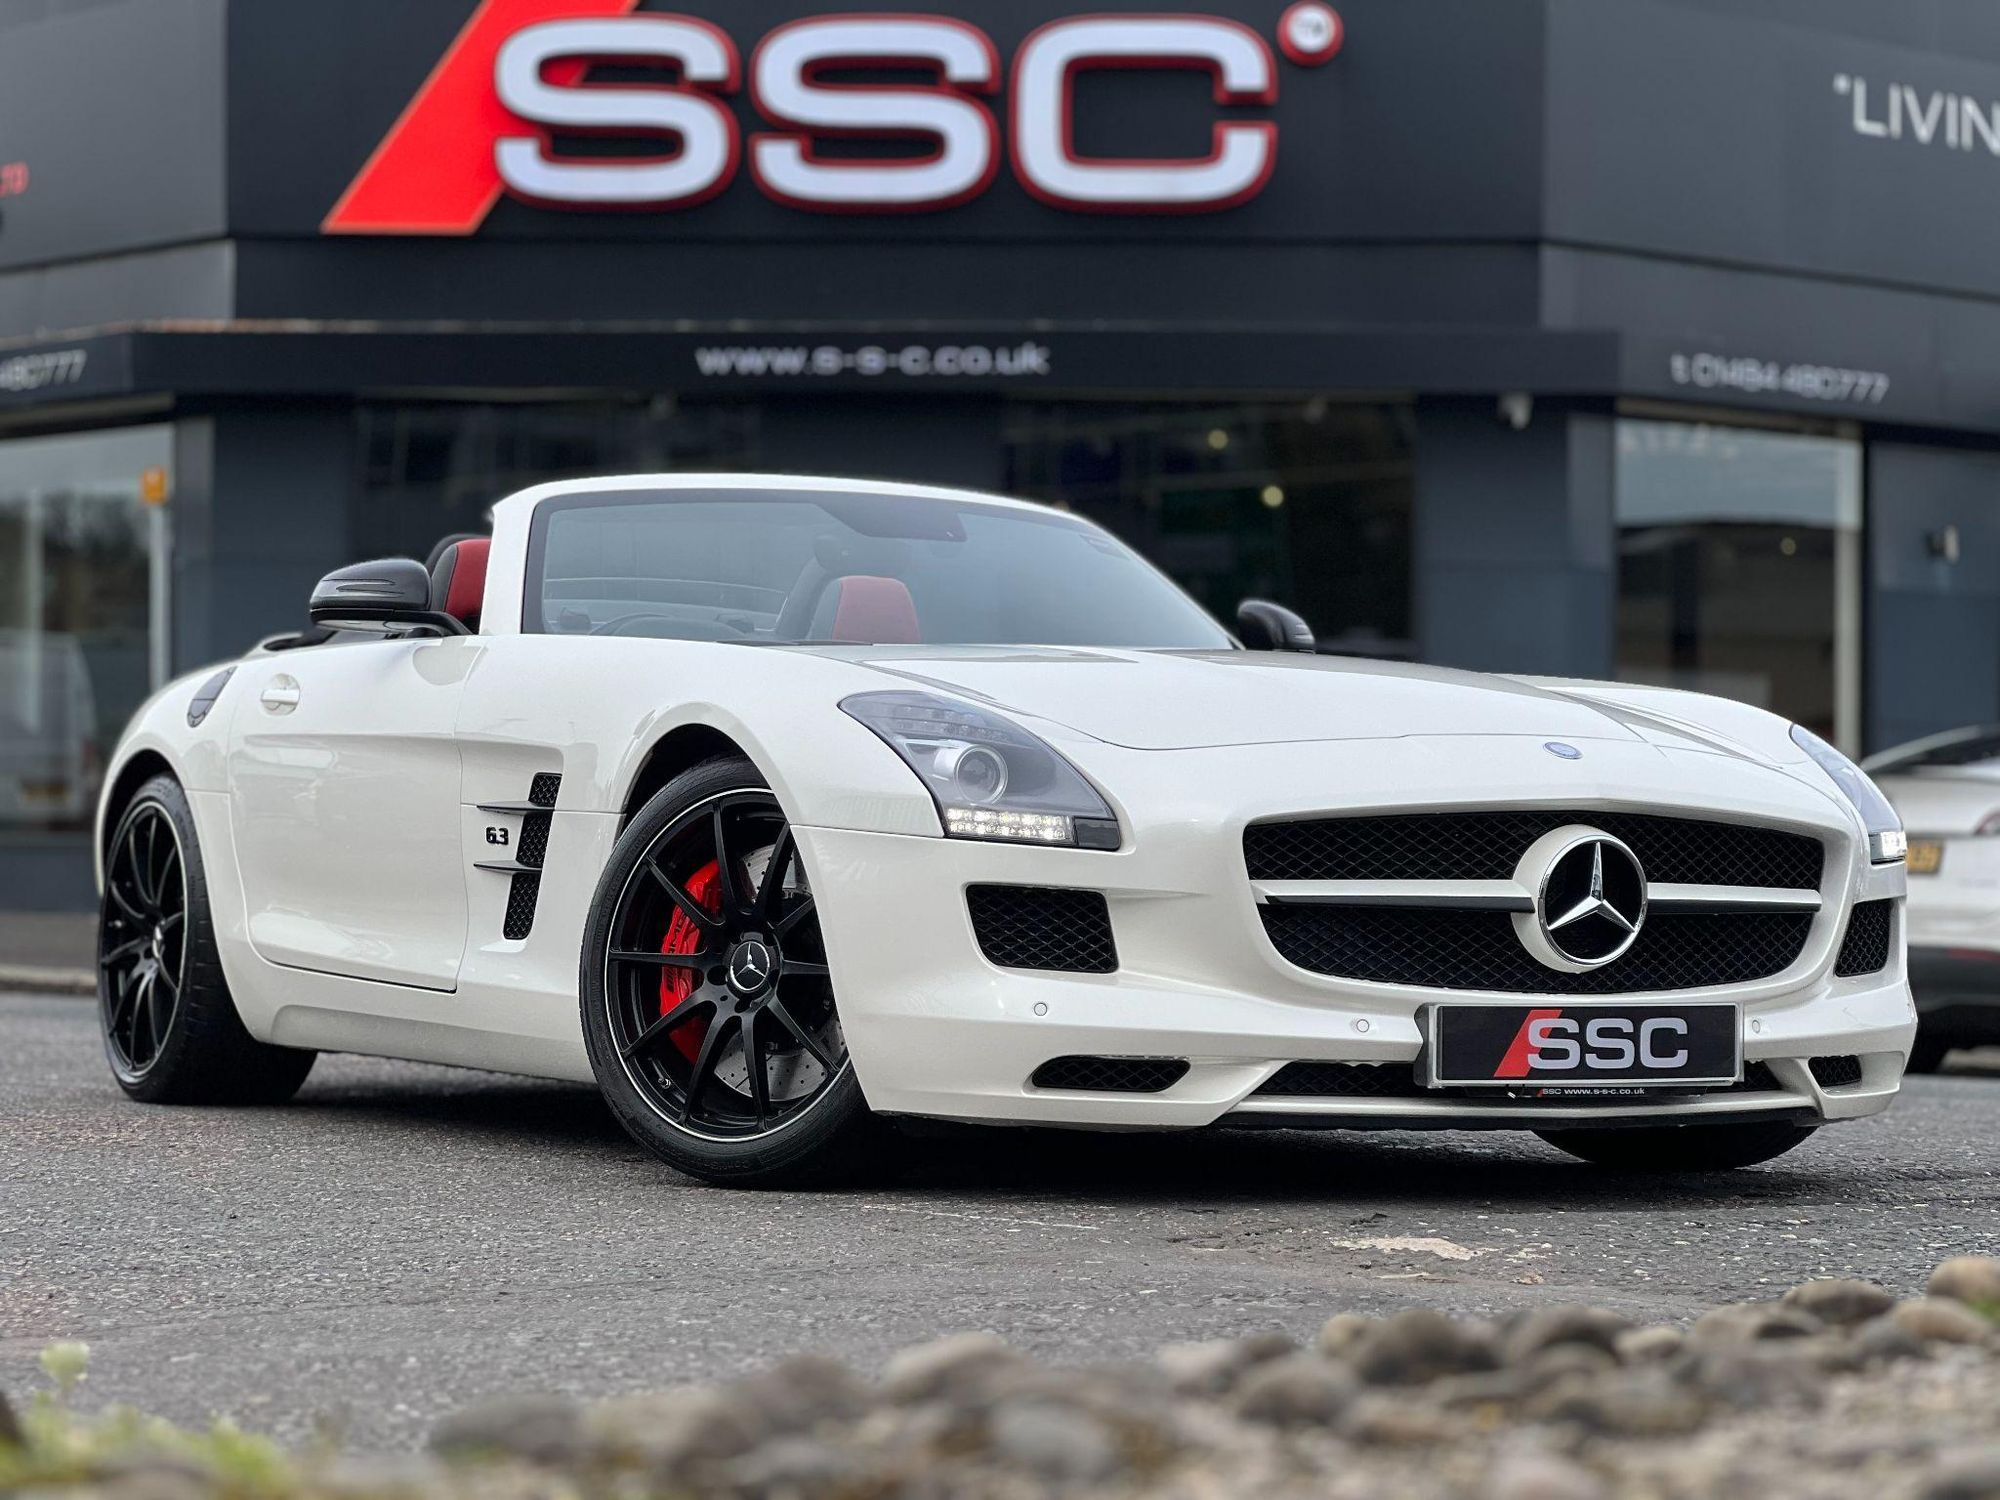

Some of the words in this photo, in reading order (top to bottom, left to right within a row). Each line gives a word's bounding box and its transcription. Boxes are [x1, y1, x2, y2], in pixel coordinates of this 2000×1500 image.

[492, 13, 1278, 212] SSC
[696, 342, 1050, 376] www.s-s-c.co.uk
[486, 827, 509, 845] 63
[1527, 1018, 1688, 1069] SSC
[1564, 1087, 1645, 1095] www.s-s-c.co.uk
